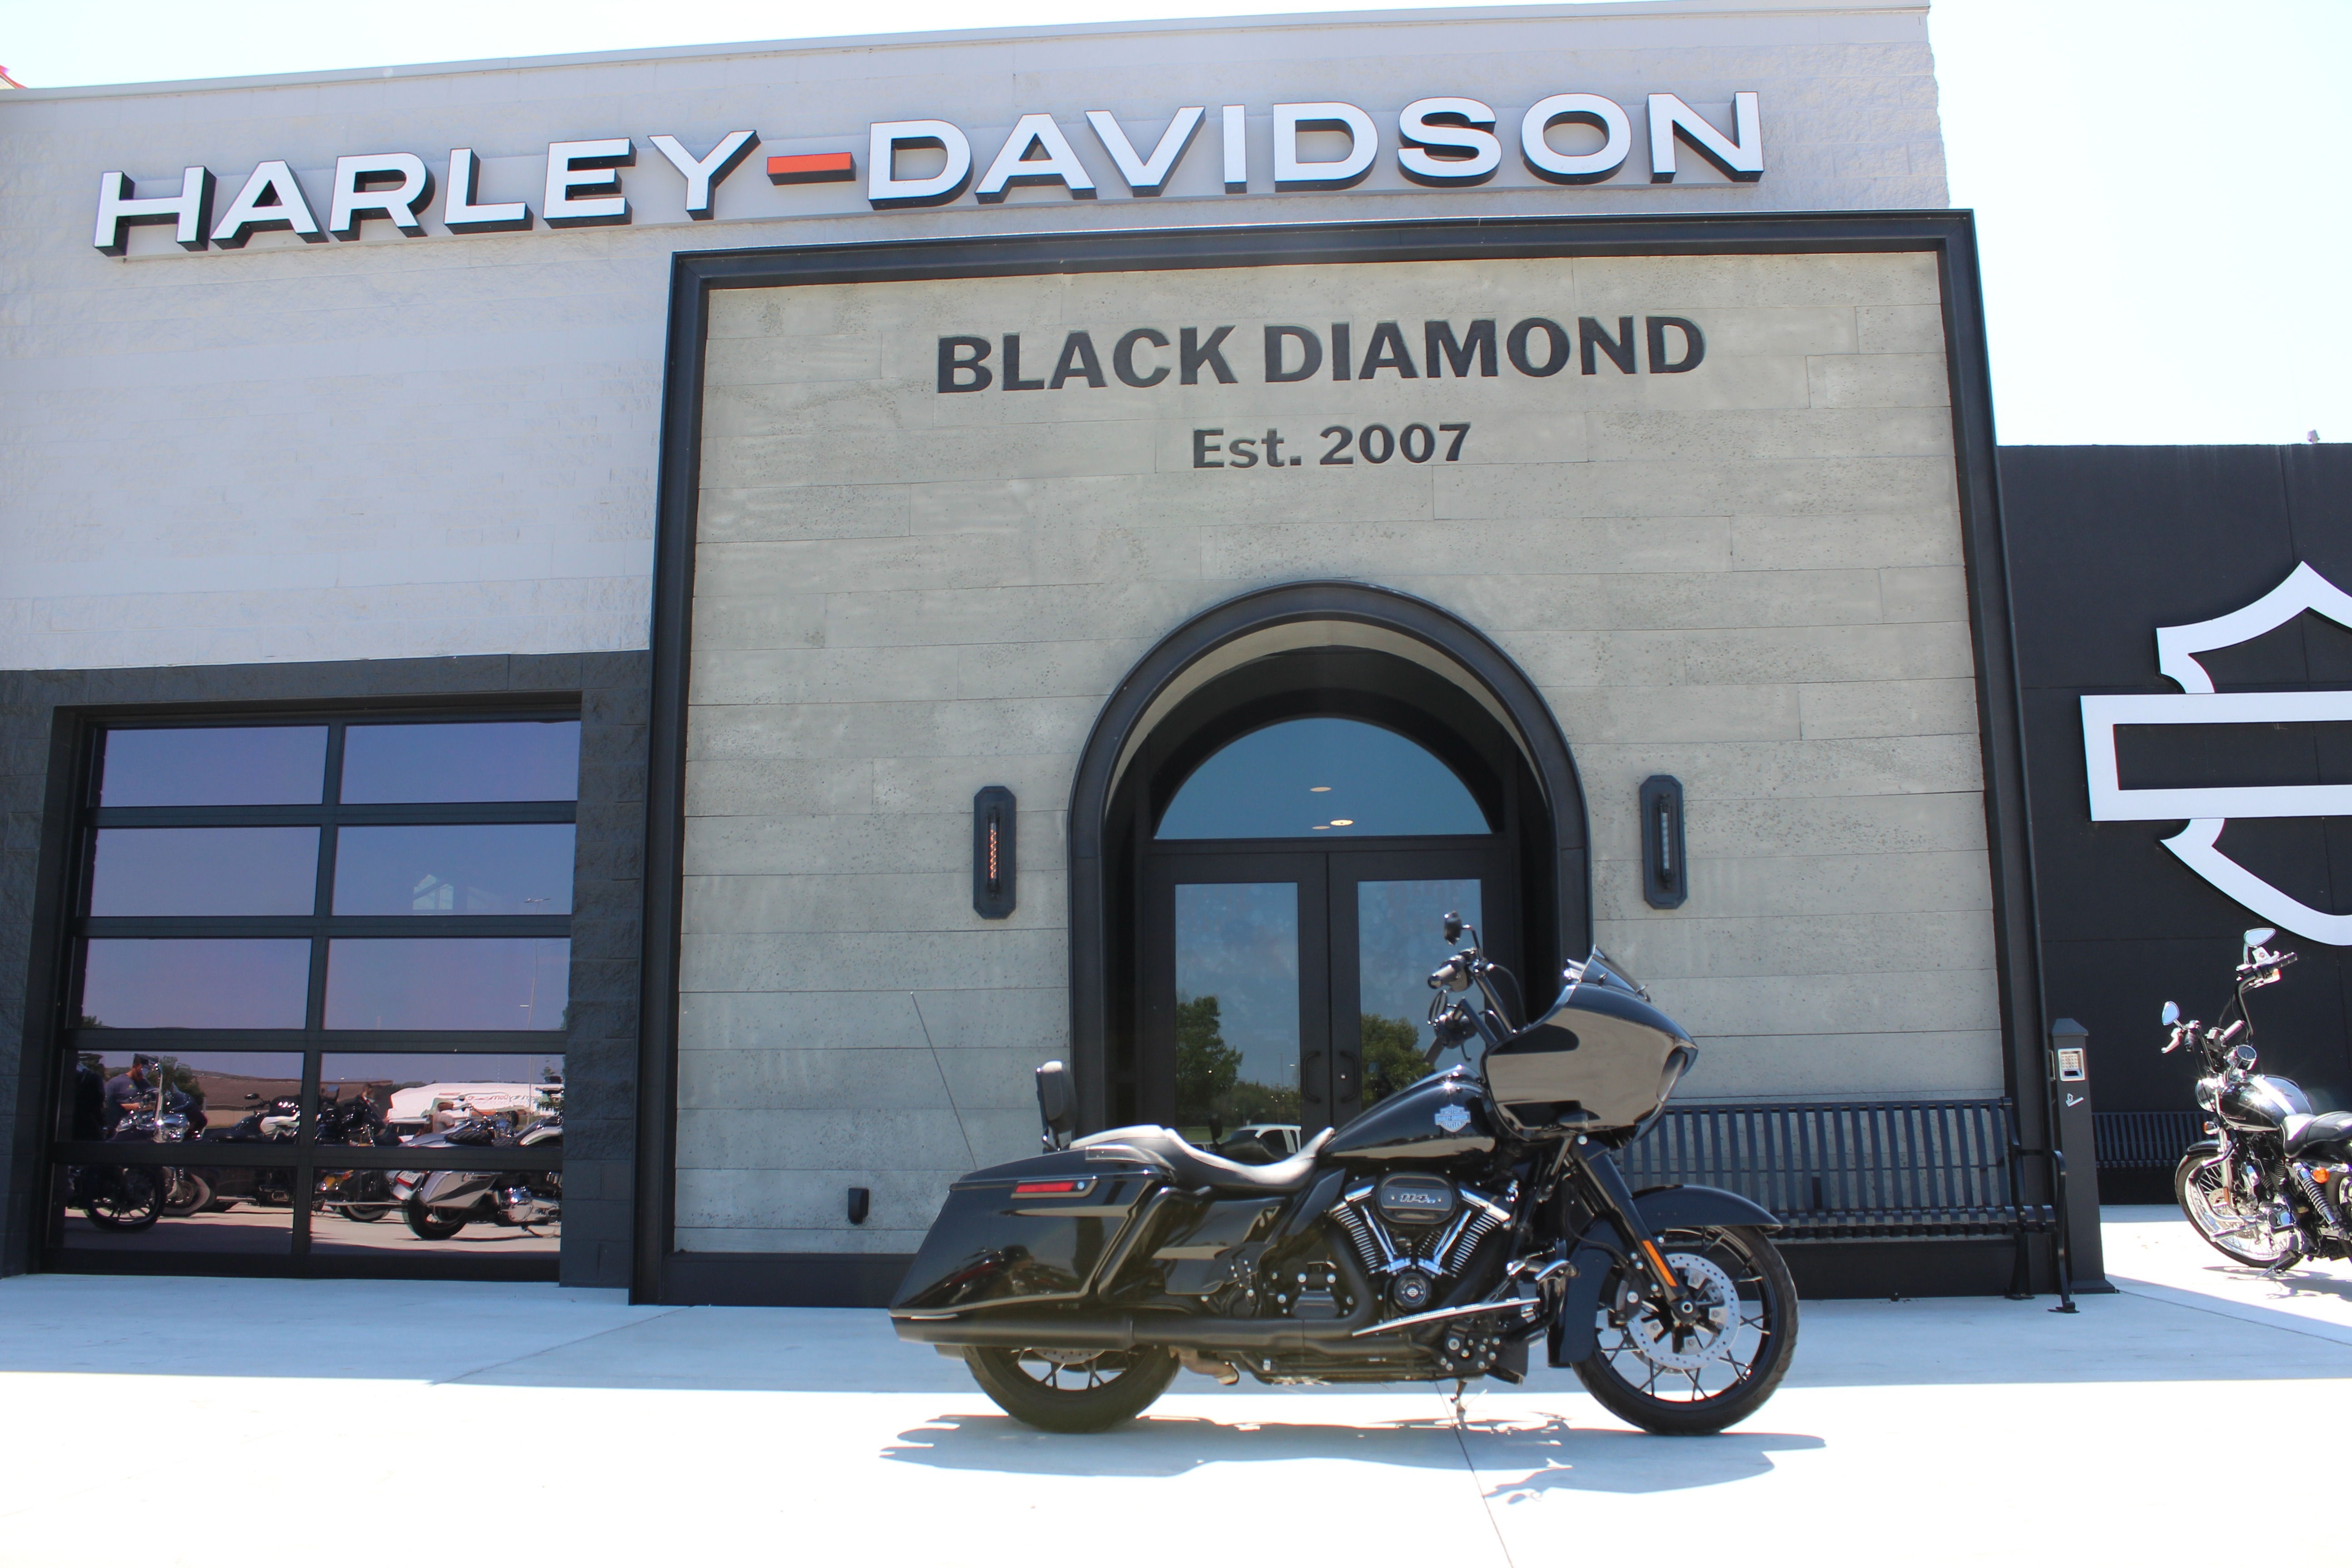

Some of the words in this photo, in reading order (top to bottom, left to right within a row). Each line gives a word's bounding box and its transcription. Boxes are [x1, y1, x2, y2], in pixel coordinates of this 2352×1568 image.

[93, 91, 1764, 255] HARLEY-DAVIDSON
[936, 324, 1239, 394] BLACK
[1264, 315, 1706, 383] DIAMOND
[1193, 428, 1302, 468] Est.
[1319, 421, 1471, 466] 2007
